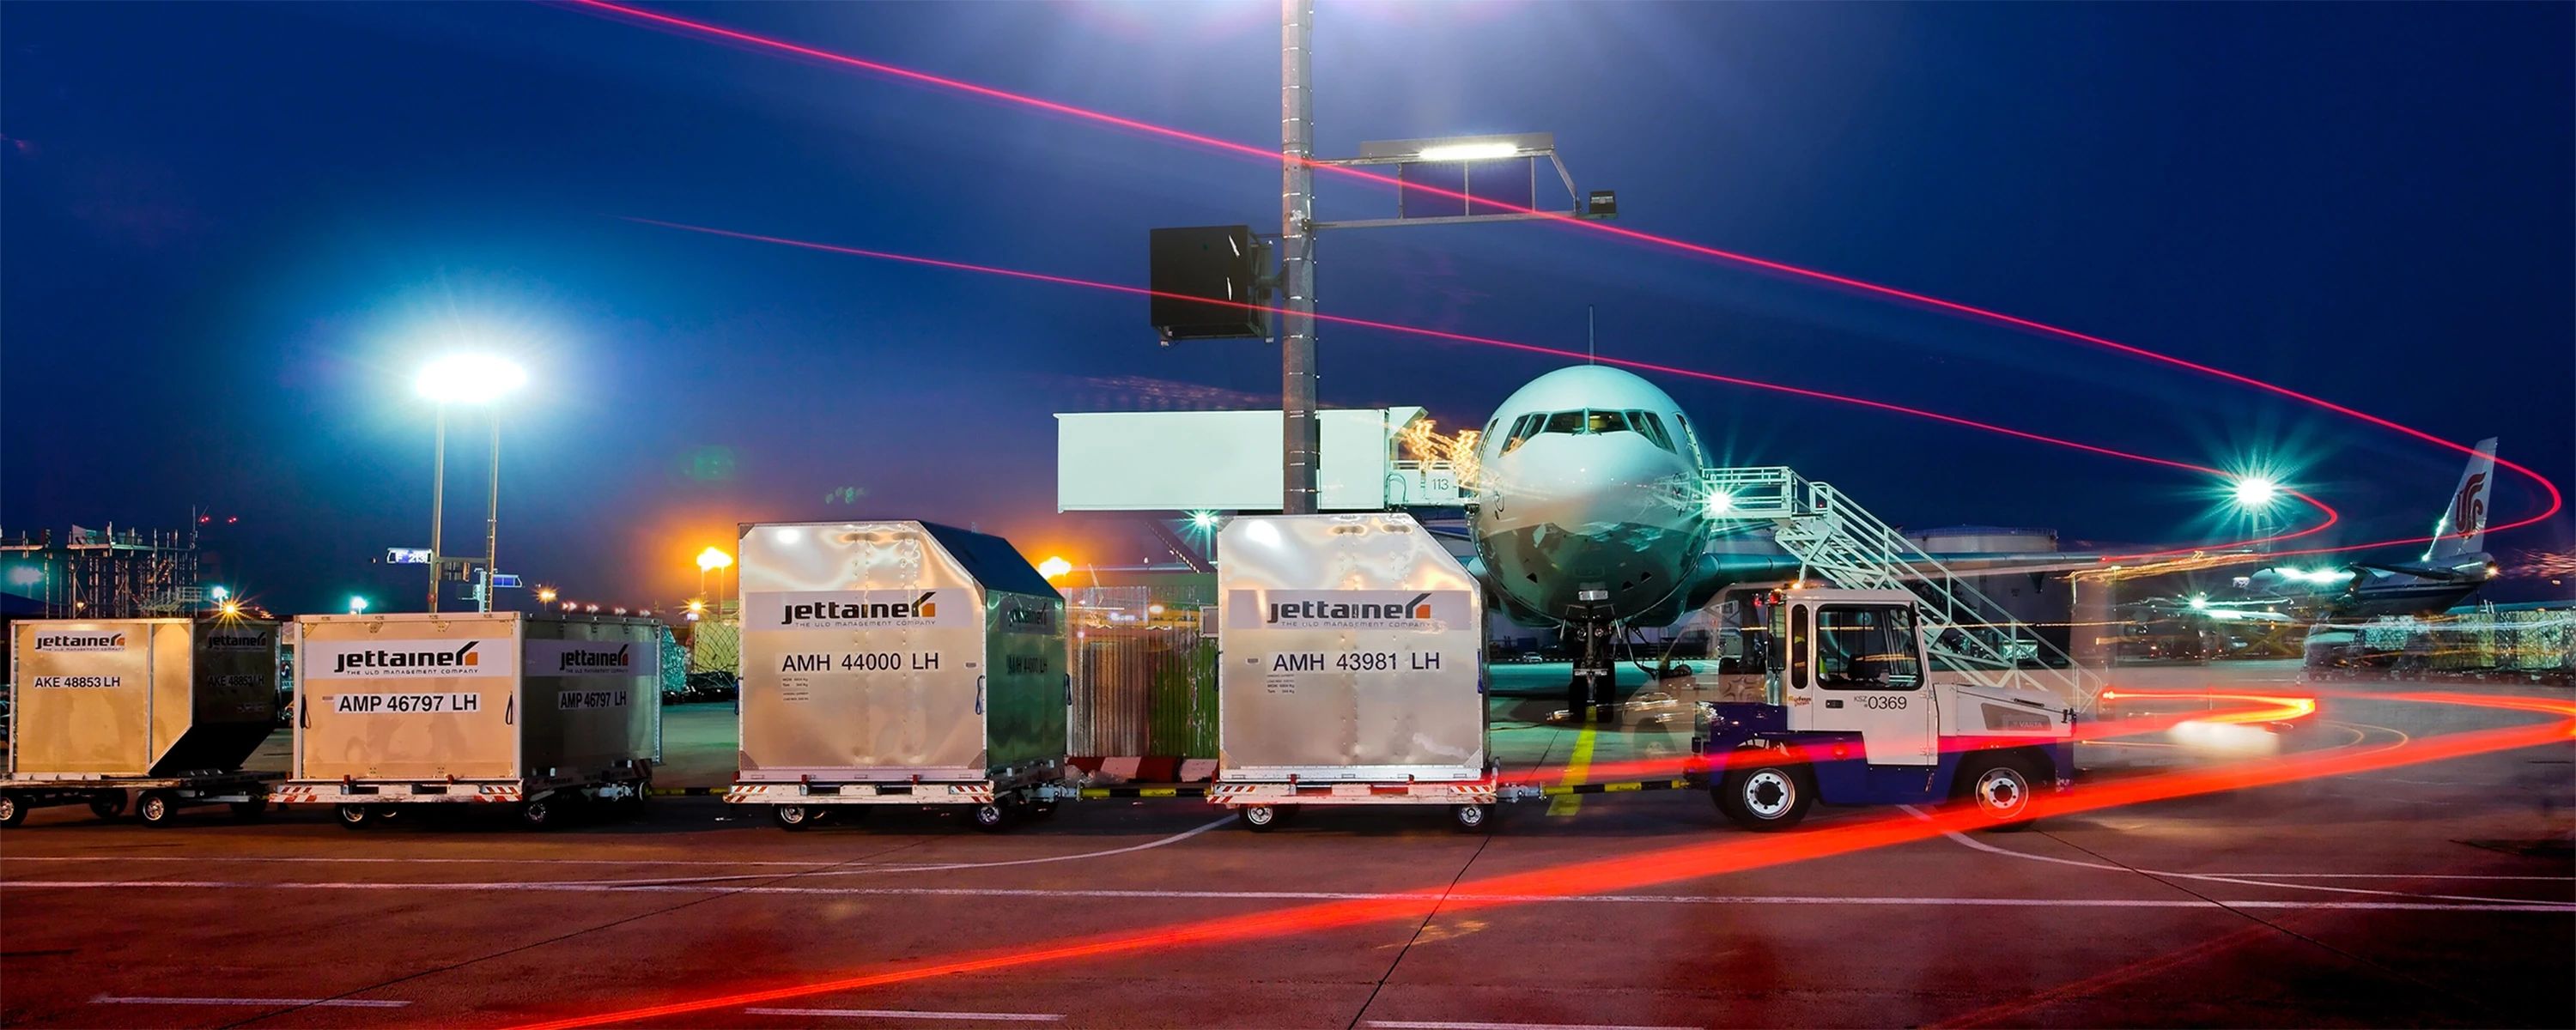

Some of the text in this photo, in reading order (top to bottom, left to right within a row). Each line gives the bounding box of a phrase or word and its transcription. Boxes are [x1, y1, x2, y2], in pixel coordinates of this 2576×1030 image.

[1432, 478, 1449, 490] 113
[781, 591, 937, 624] jettainer
[1267, 593, 1432, 623] jettainer
[35, 633, 123, 650] jettainer
[208, 632, 266, 648] jettainer
[334, 641, 480, 673] jettainer
[560, 644, 629, 670] jettainer
[782, 652, 939, 672] AMH 44000 LH
[1273, 652, 1440, 671] AMH 43981 LH
[35, 676, 120, 688] AKE 48853 LH
[338, 694, 477, 712] AMP 46797 LH
[560, 691, 627, 708] AMP 46797 LH
[1868, 696, 1907, 710] 0369
